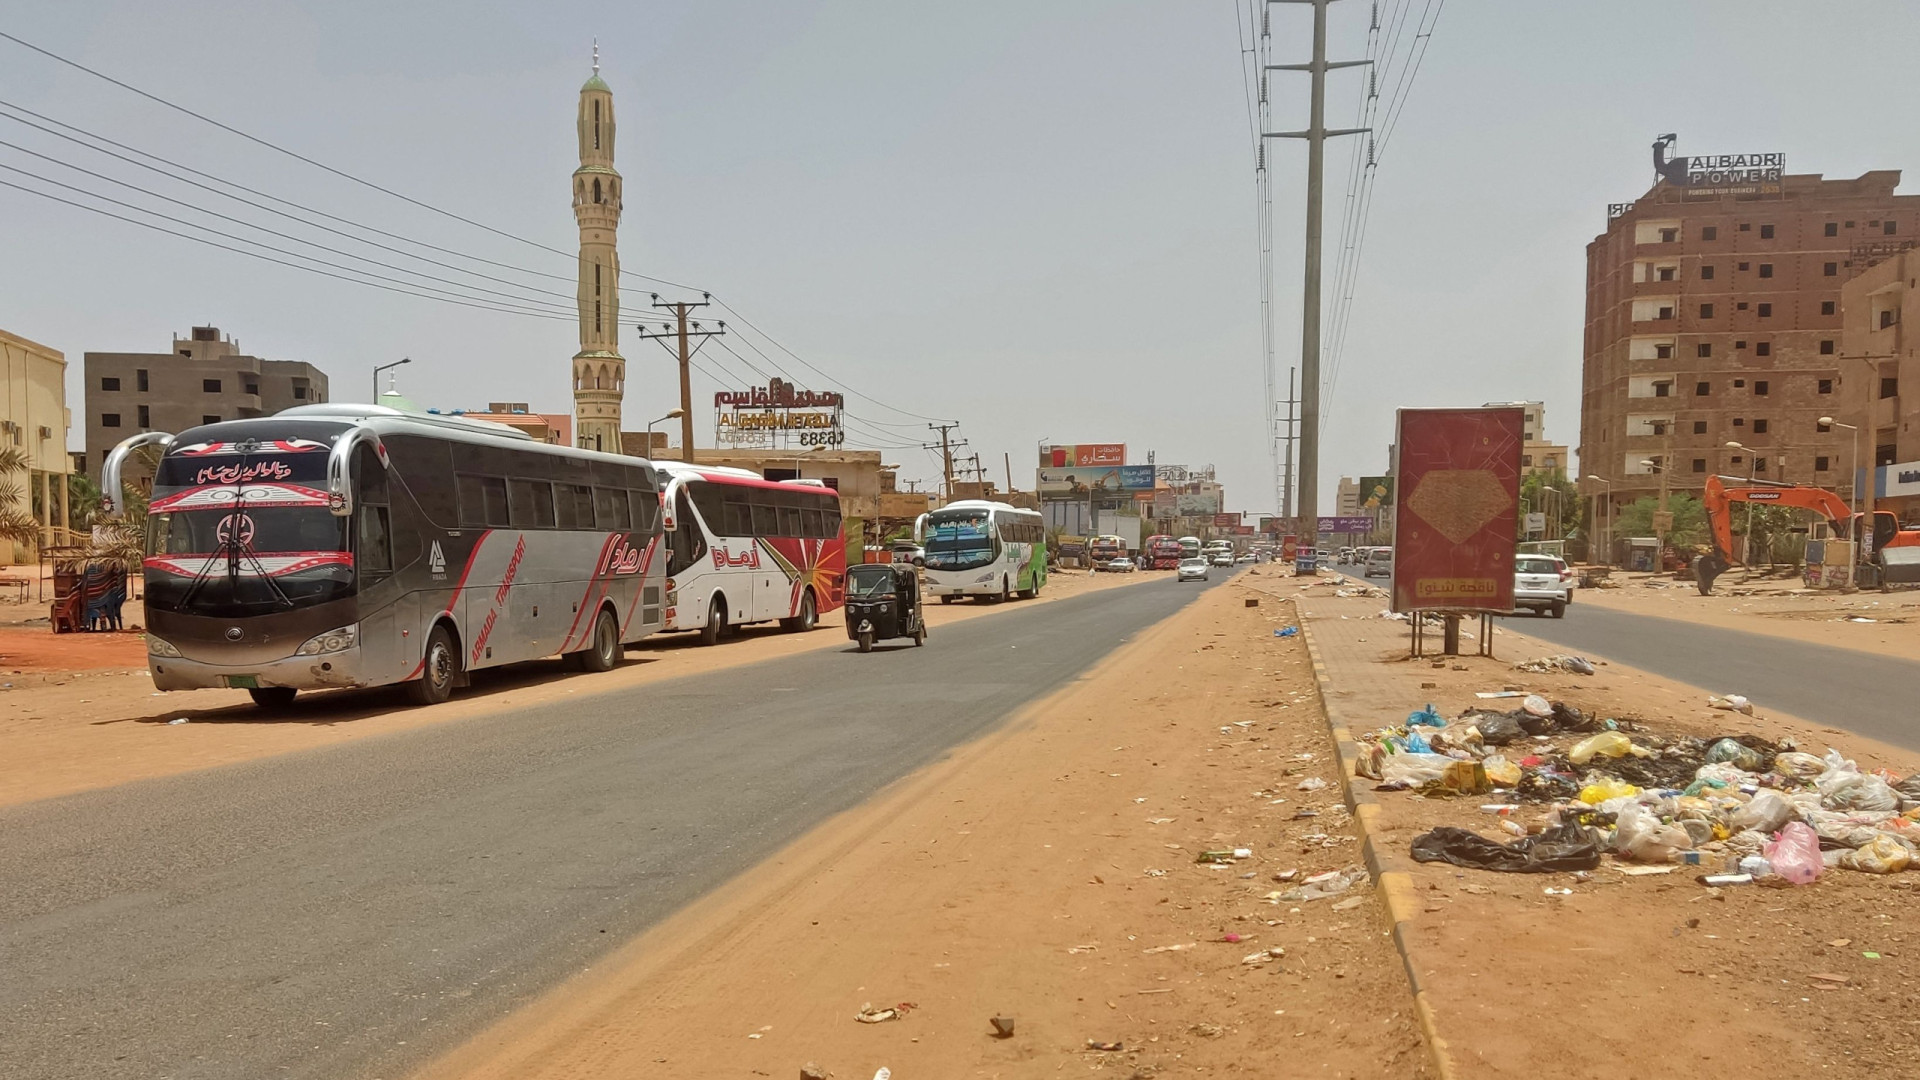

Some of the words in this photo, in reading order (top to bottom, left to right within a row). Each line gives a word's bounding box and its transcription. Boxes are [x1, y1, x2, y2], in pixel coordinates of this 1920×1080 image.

[1690, 153, 1782, 169] ALBADRI
[1692, 170, 1778, 184] POWER
[1460, 581, 1494, 593] ناقصة
[472, 608, 498, 665] ARMADA
[495, 533, 526, 607] TRANSPORT
